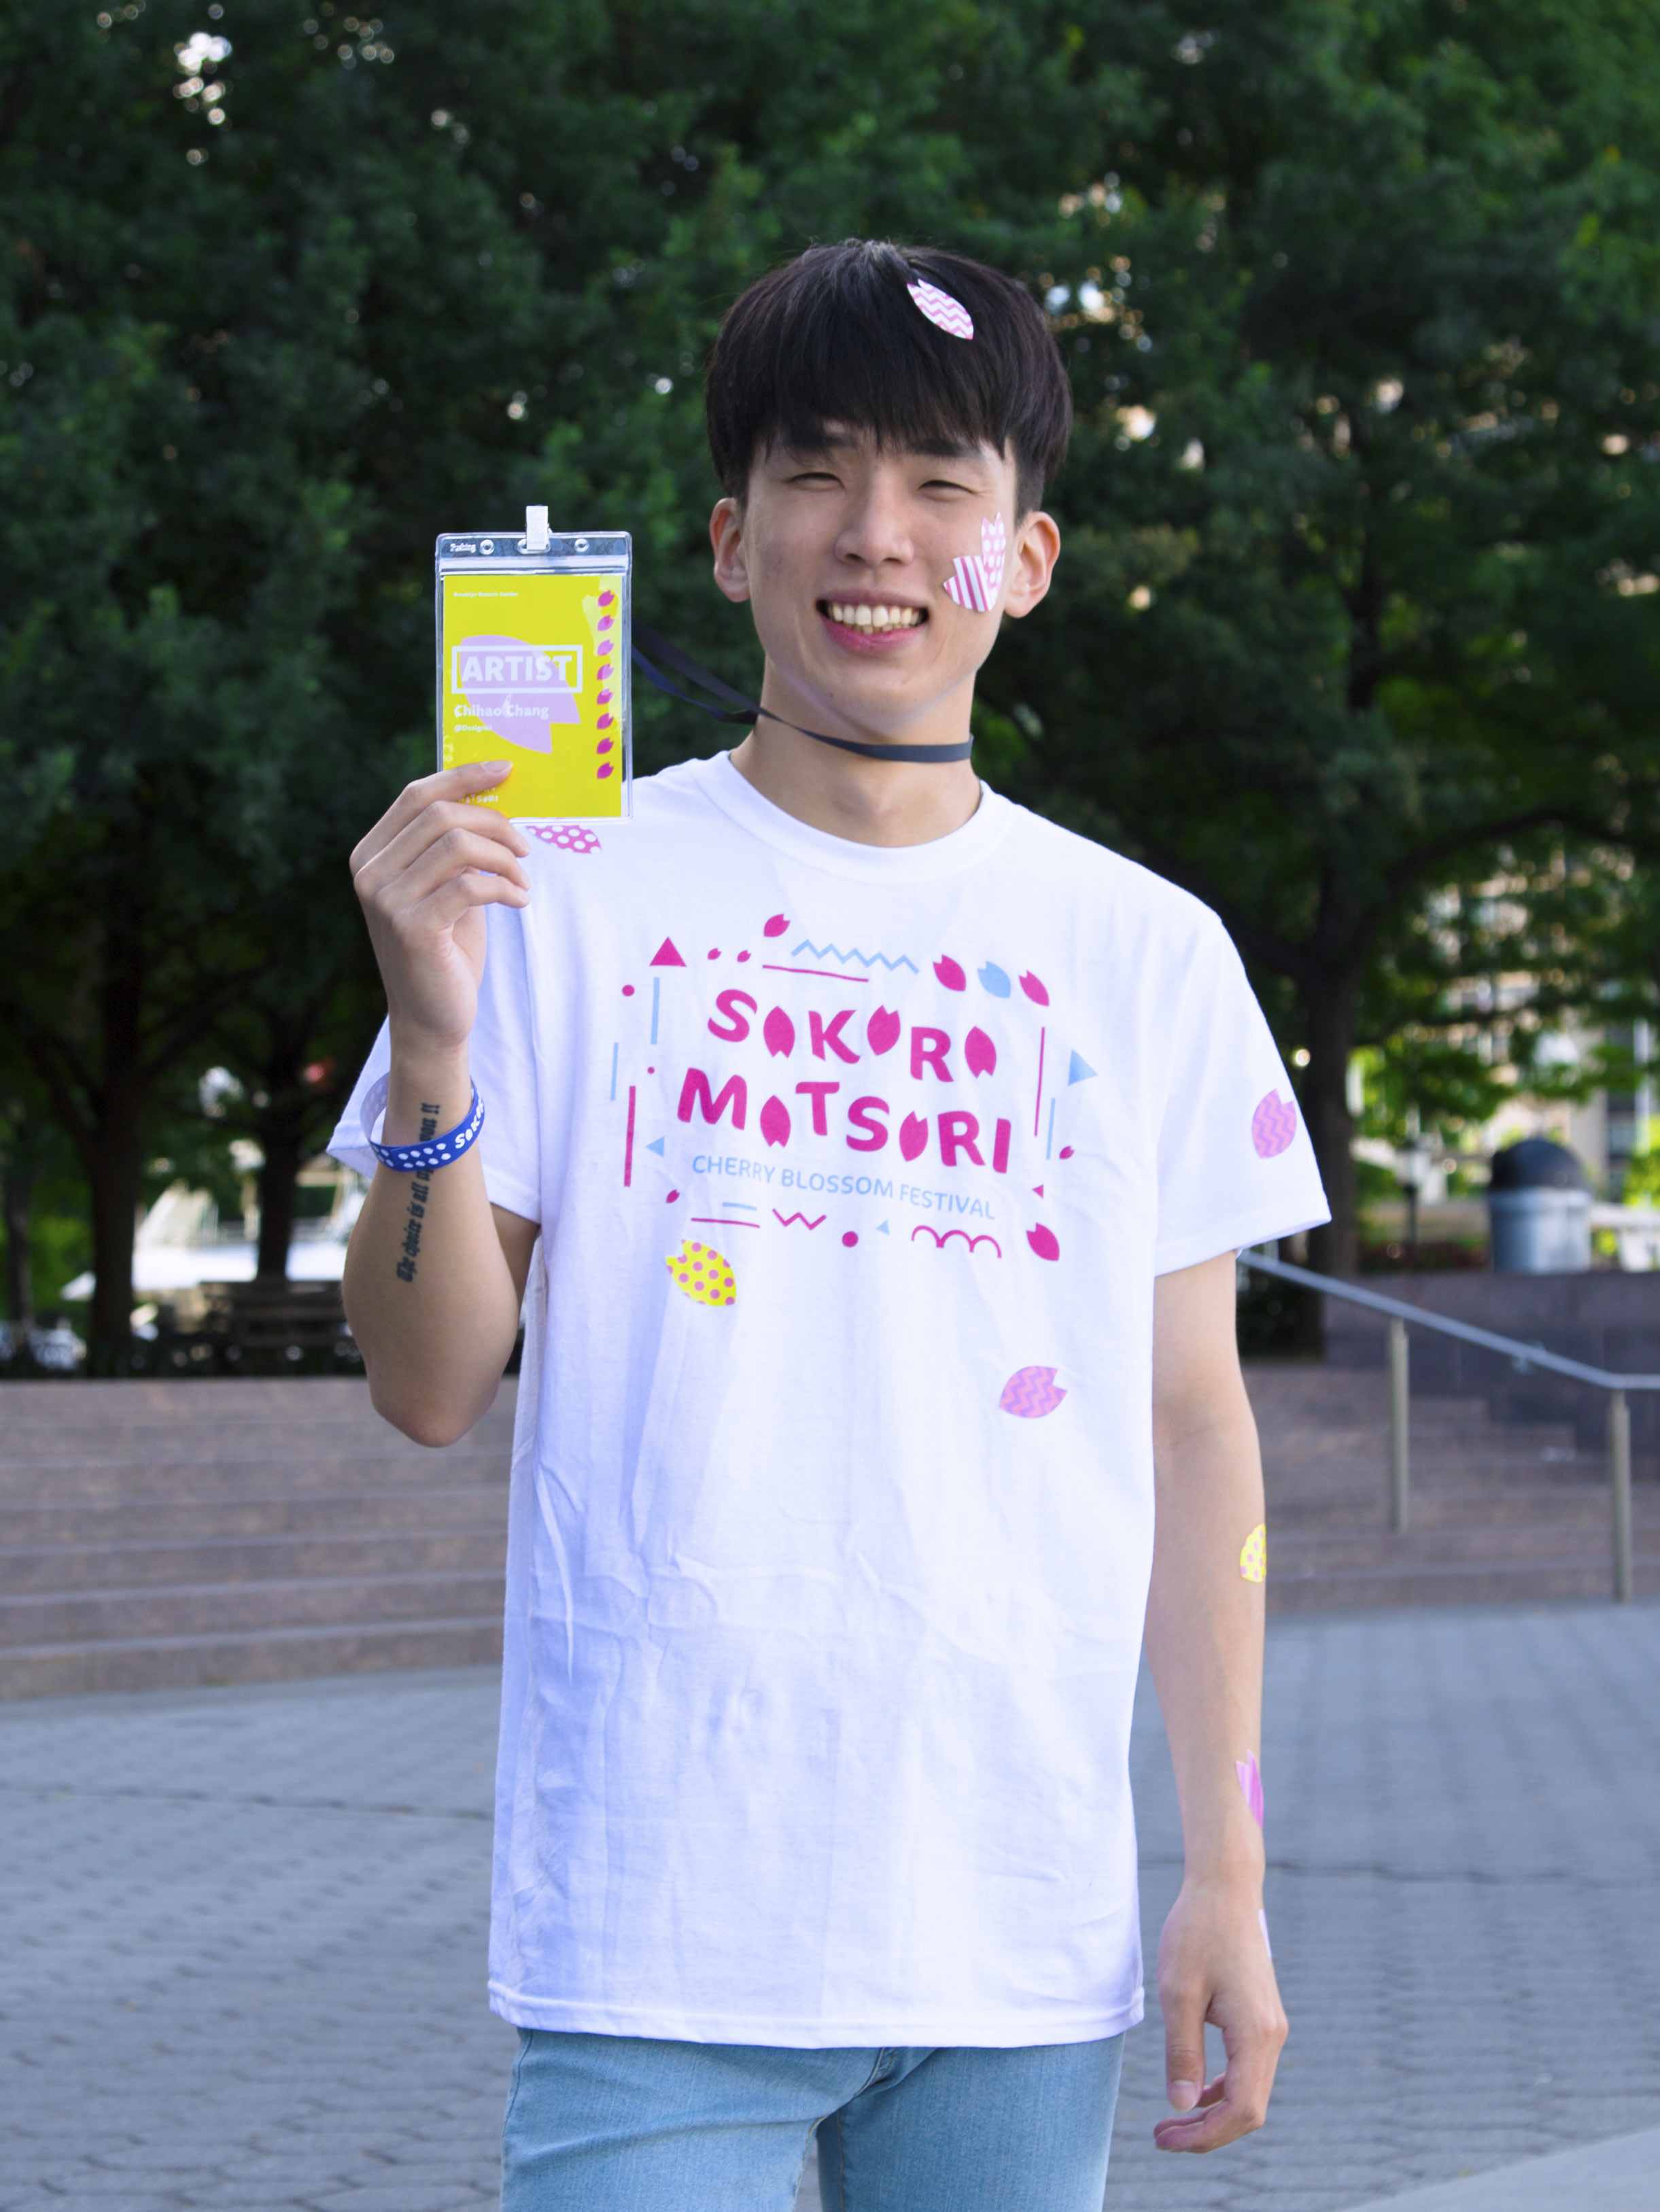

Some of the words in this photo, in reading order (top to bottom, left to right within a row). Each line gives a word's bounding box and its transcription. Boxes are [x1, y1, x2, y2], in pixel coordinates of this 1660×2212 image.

[462, 655, 572, 682] ARTIST
[454, 704, 502, 716] Chihao
[504, 704, 549, 720] Chang
[692, 1155, 776, 1183] CHERRY
[781, 1169, 894, 1198] BLOSSOM
[899, 1183, 996, 1220] FESTIVAL
